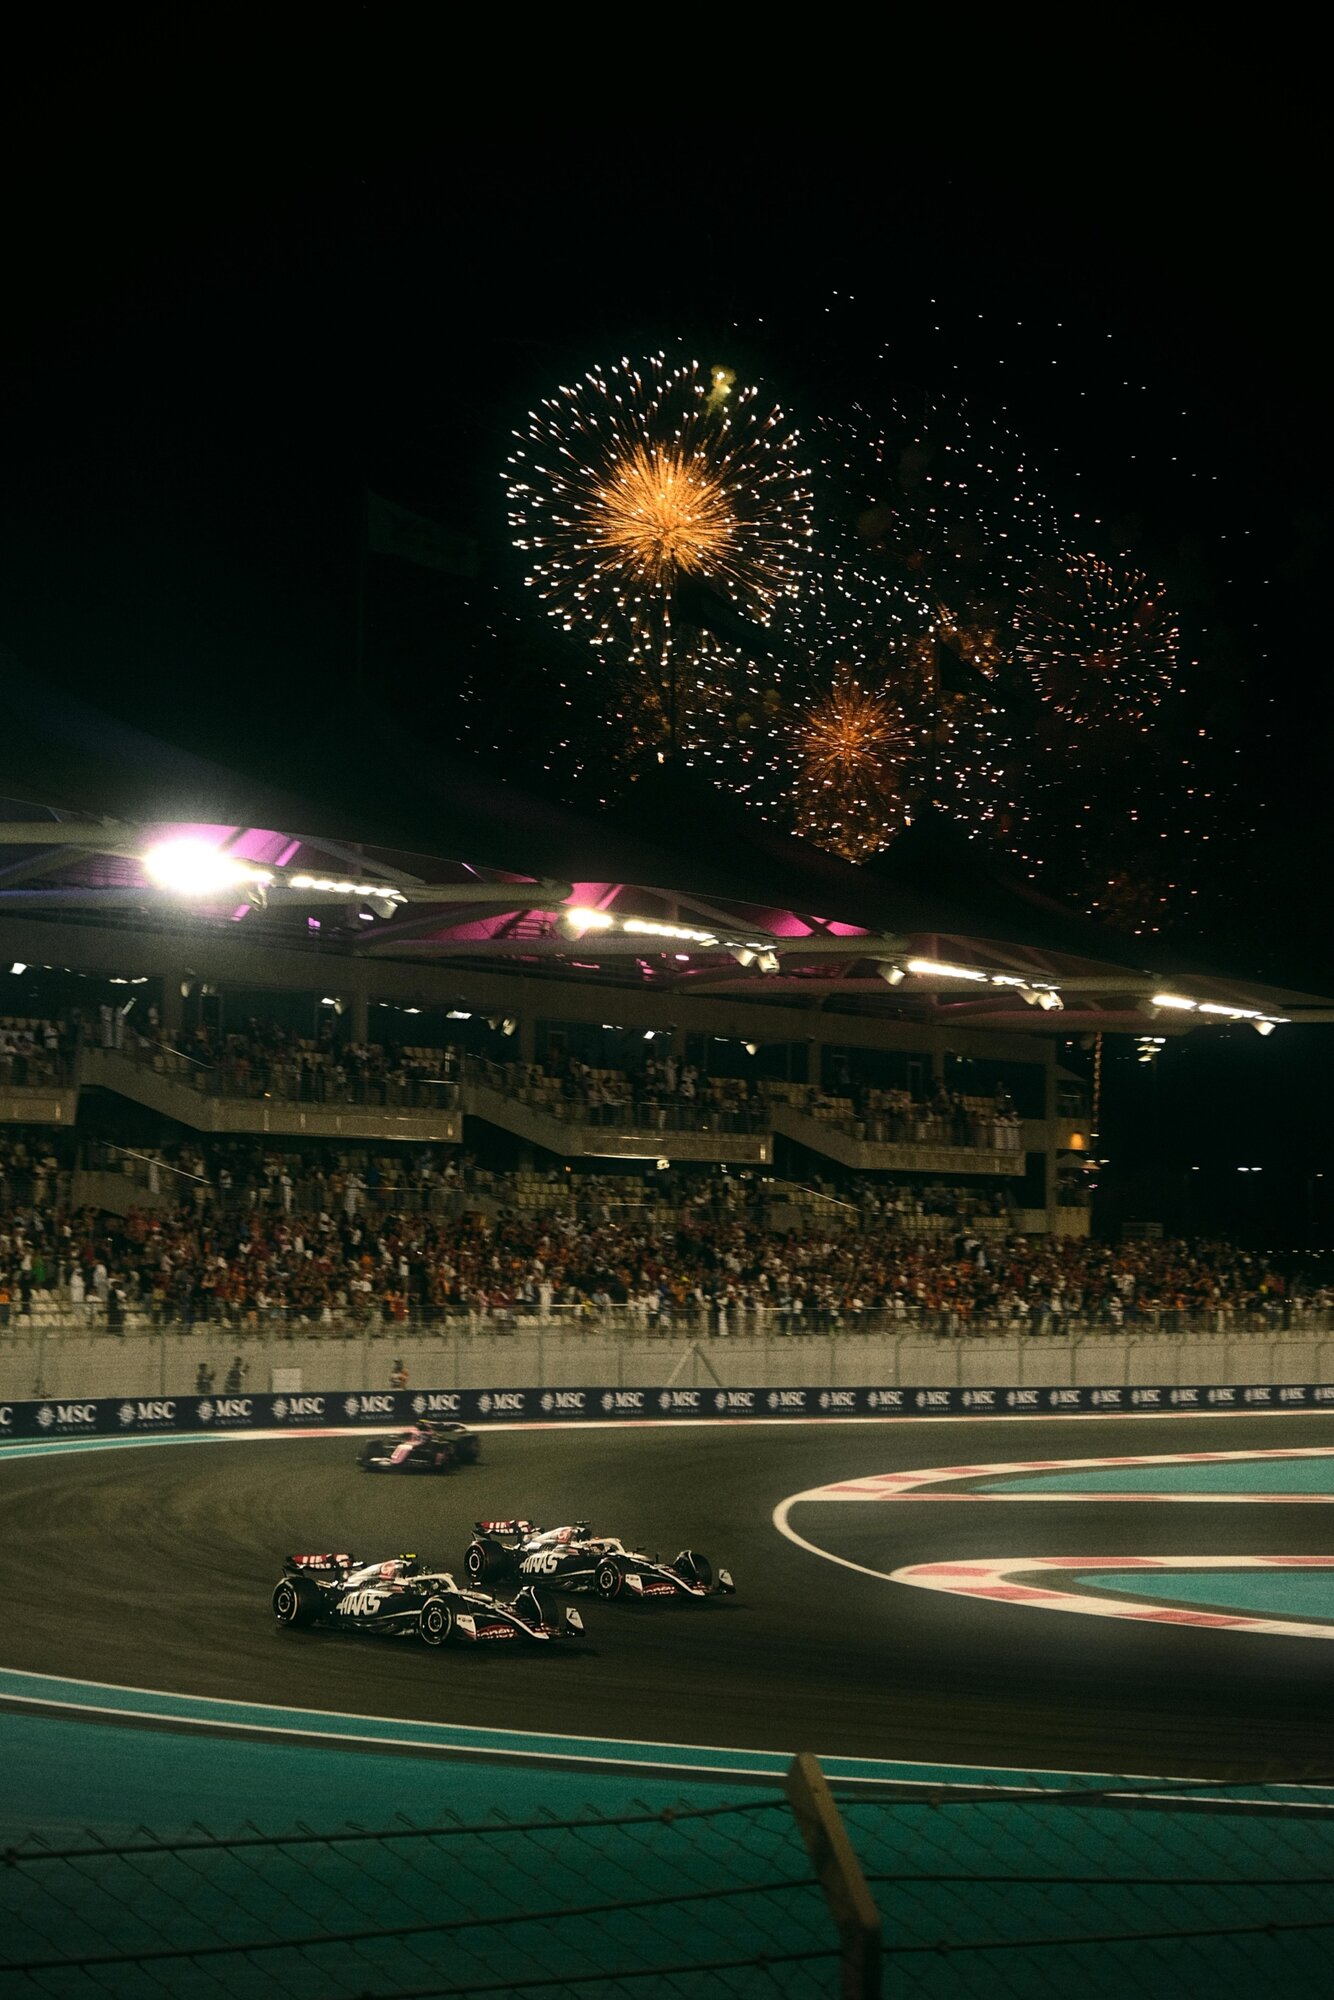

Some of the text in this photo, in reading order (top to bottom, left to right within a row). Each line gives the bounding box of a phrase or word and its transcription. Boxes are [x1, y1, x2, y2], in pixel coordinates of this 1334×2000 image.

[361, 1396, 394, 1412] MSC
[428, 1395, 460, 1410] MSC
[494, 1394, 524, 1409] MSC
[556, 1393, 585, 1407] MSC
[616, 1393, 644, 1407] MSC
[672, 1392, 700, 1406] MSC
[728, 1392, 754, 1406] MSC
[779, 1392, 806, 1405] MSC
[830, 1392, 855, 1405] MSC
[878, 1392, 903, 1404] MSC
[138, 1402, 175, 1419] MSC
[216, 1400, 251, 1416] MSC
[290, 1398, 324, 1414] MSC
[57, 1405, 96, 1423] MSC
